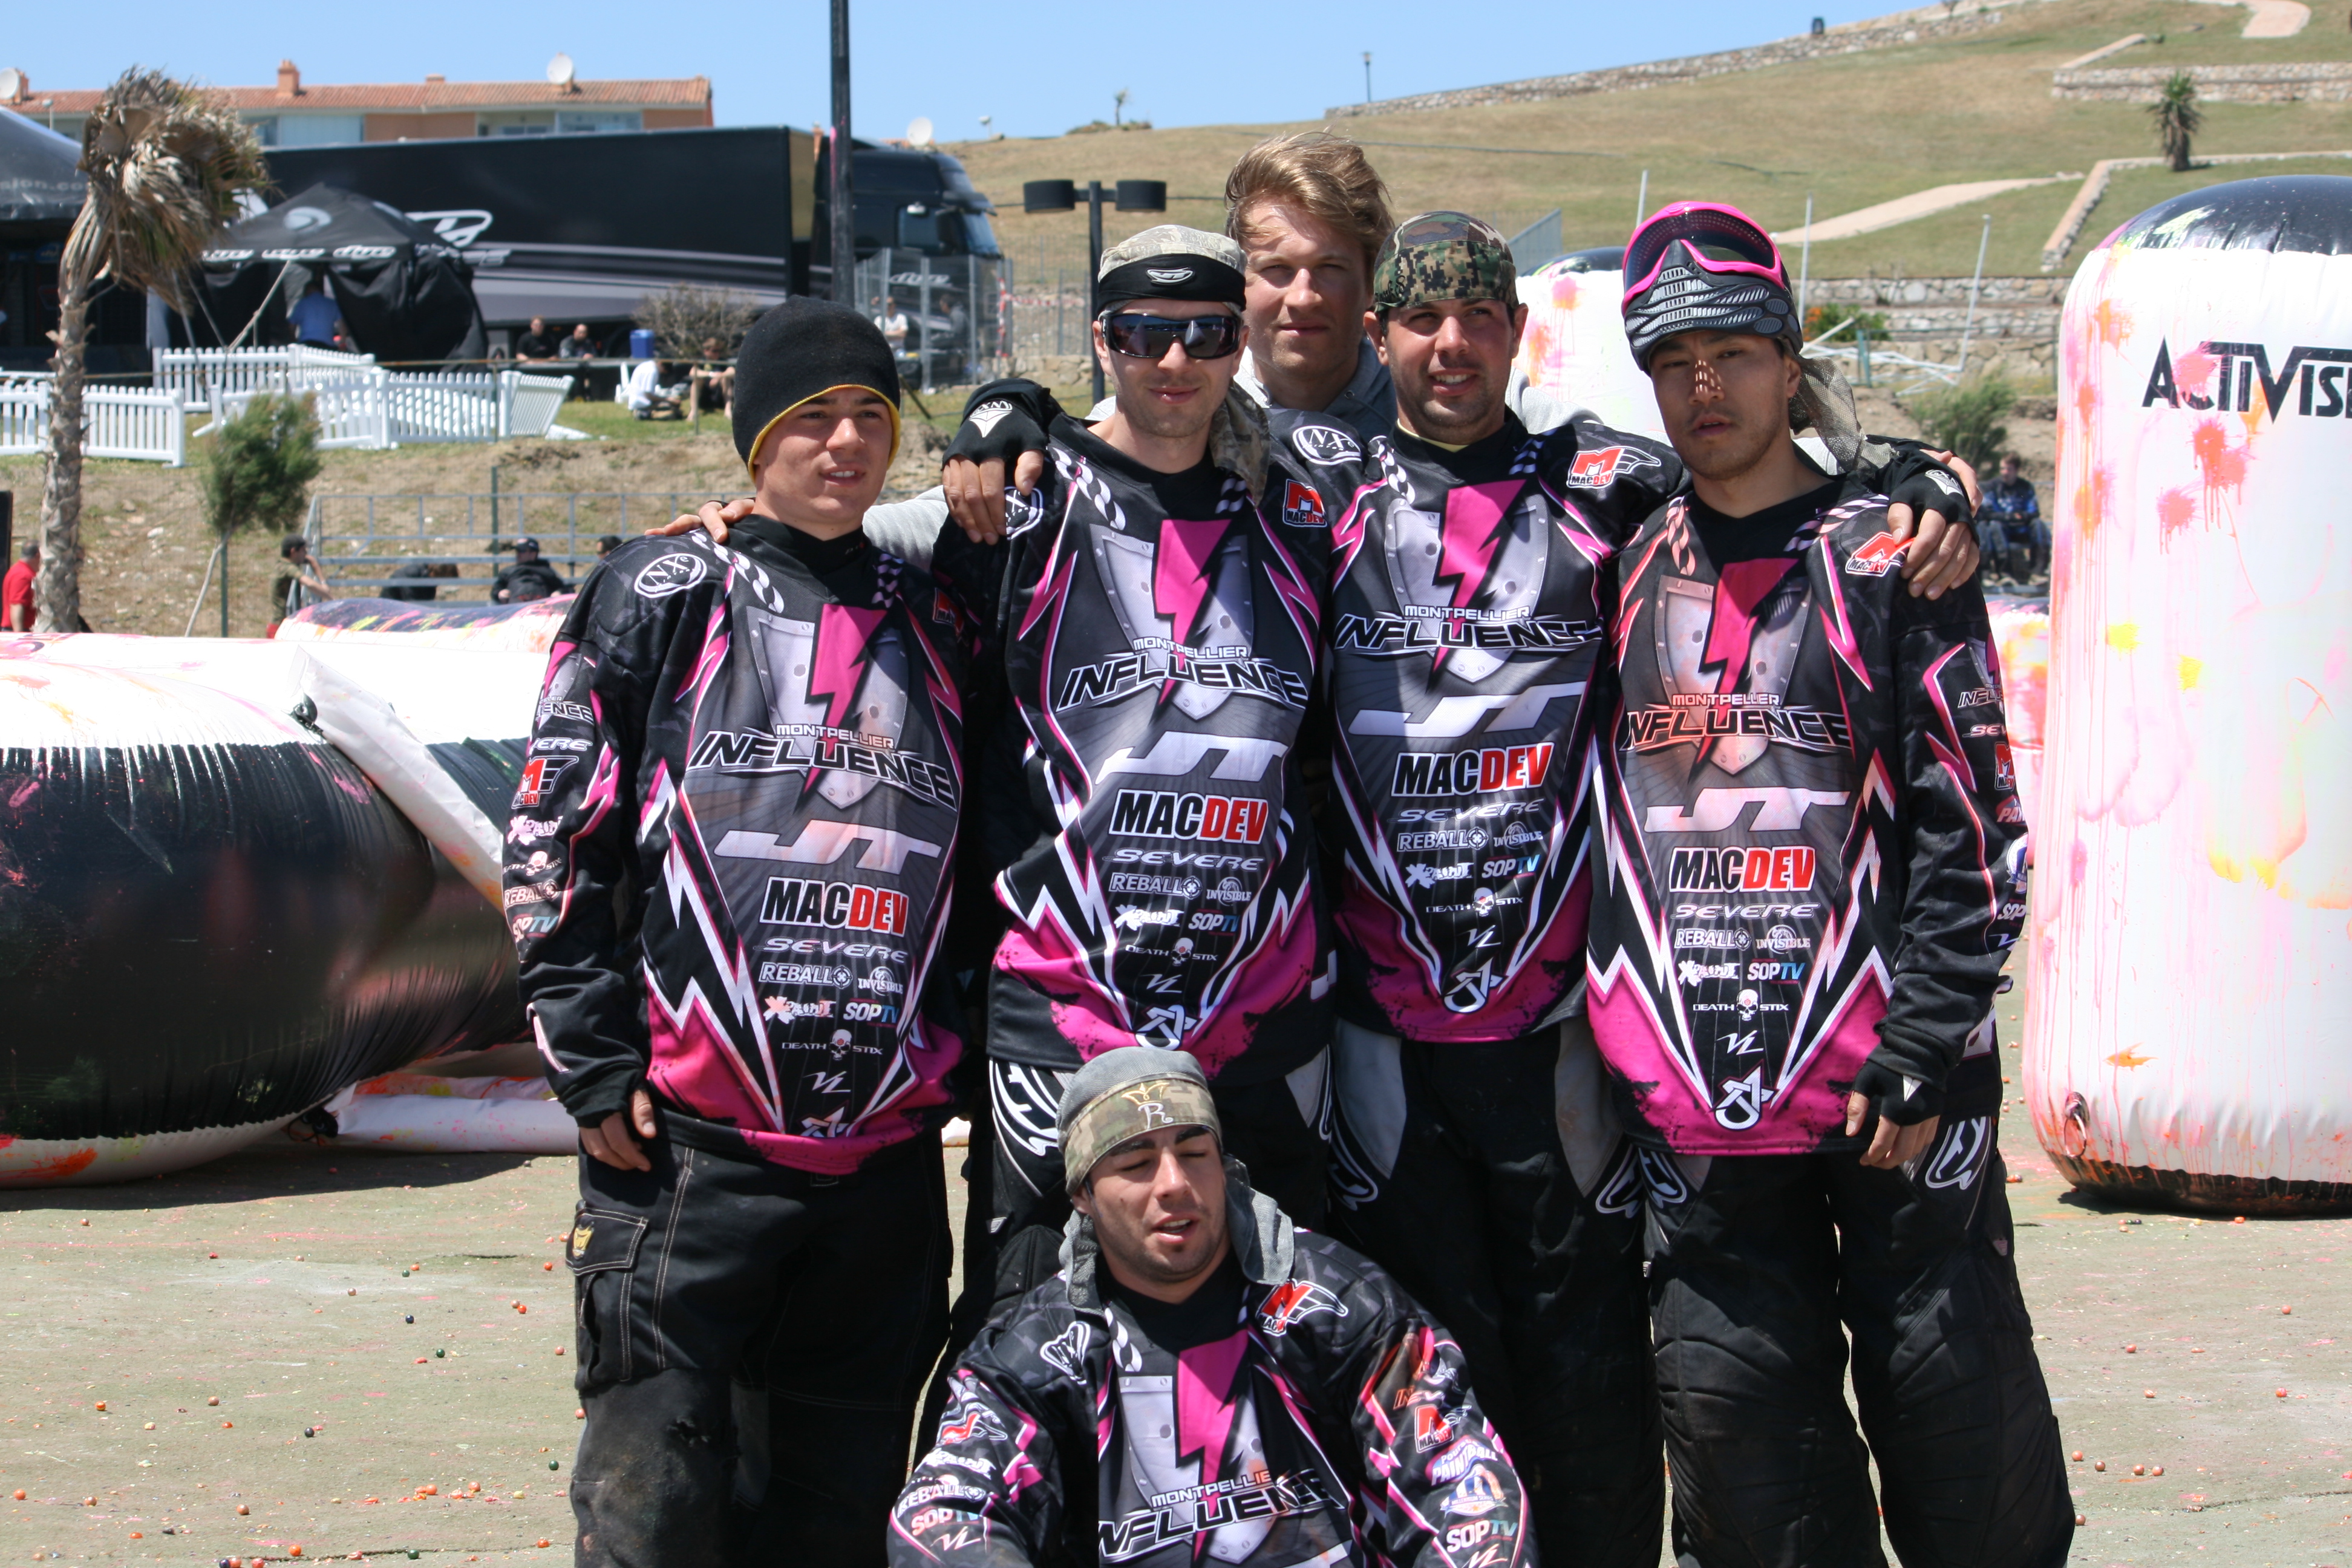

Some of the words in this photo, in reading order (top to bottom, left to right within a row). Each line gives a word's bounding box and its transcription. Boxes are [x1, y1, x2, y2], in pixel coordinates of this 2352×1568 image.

[1405, 605, 1530, 621] MONTPELLIER
[1333, 613, 1602, 651] INFLUENCE
[1133, 636, 1249, 659] MONTPELLIER
[1055, 652, 1309, 713] INFLUENCE
[776, 724, 895, 750] MONTPELLIER
[685, 730, 959, 813] INFLUENCE
[1391, 741, 1556, 797] MACDEV
[1108, 788, 1269, 844] MACDEV
[1388, 799, 1545, 823] SEVERE
[1493, 831, 1544, 847] INVISIBLE
[1102, 848, 1266, 872] SEVERE
[1668, 845, 1816, 893] MACDEV
[759, 875, 909, 938] MACDEV
[1206, 889, 1252, 902] INVISIBLE
[1426, 904, 1472, 913] DEATH
[1495, 896, 1524, 906] STIX
[1671, 902, 1821, 920] SEVERE
[754, 936, 908, 964] SEVERE
[1125, 944, 1169, 956] DEATH
[1192, 953, 1218, 962] STIX
[1756, 938, 1811, 950] INVISIBLE
[857, 977, 904, 994] INVISIBLE
[1693, 1002, 1734, 1011] DEATH
[1759, 1003, 1789, 1011] STIX
[782, 1042, 827, 1051] DEATH
[852, 1045, 884, 1056] STIX
[1151, 1470, 1271, 1508] MONTPELLIE
